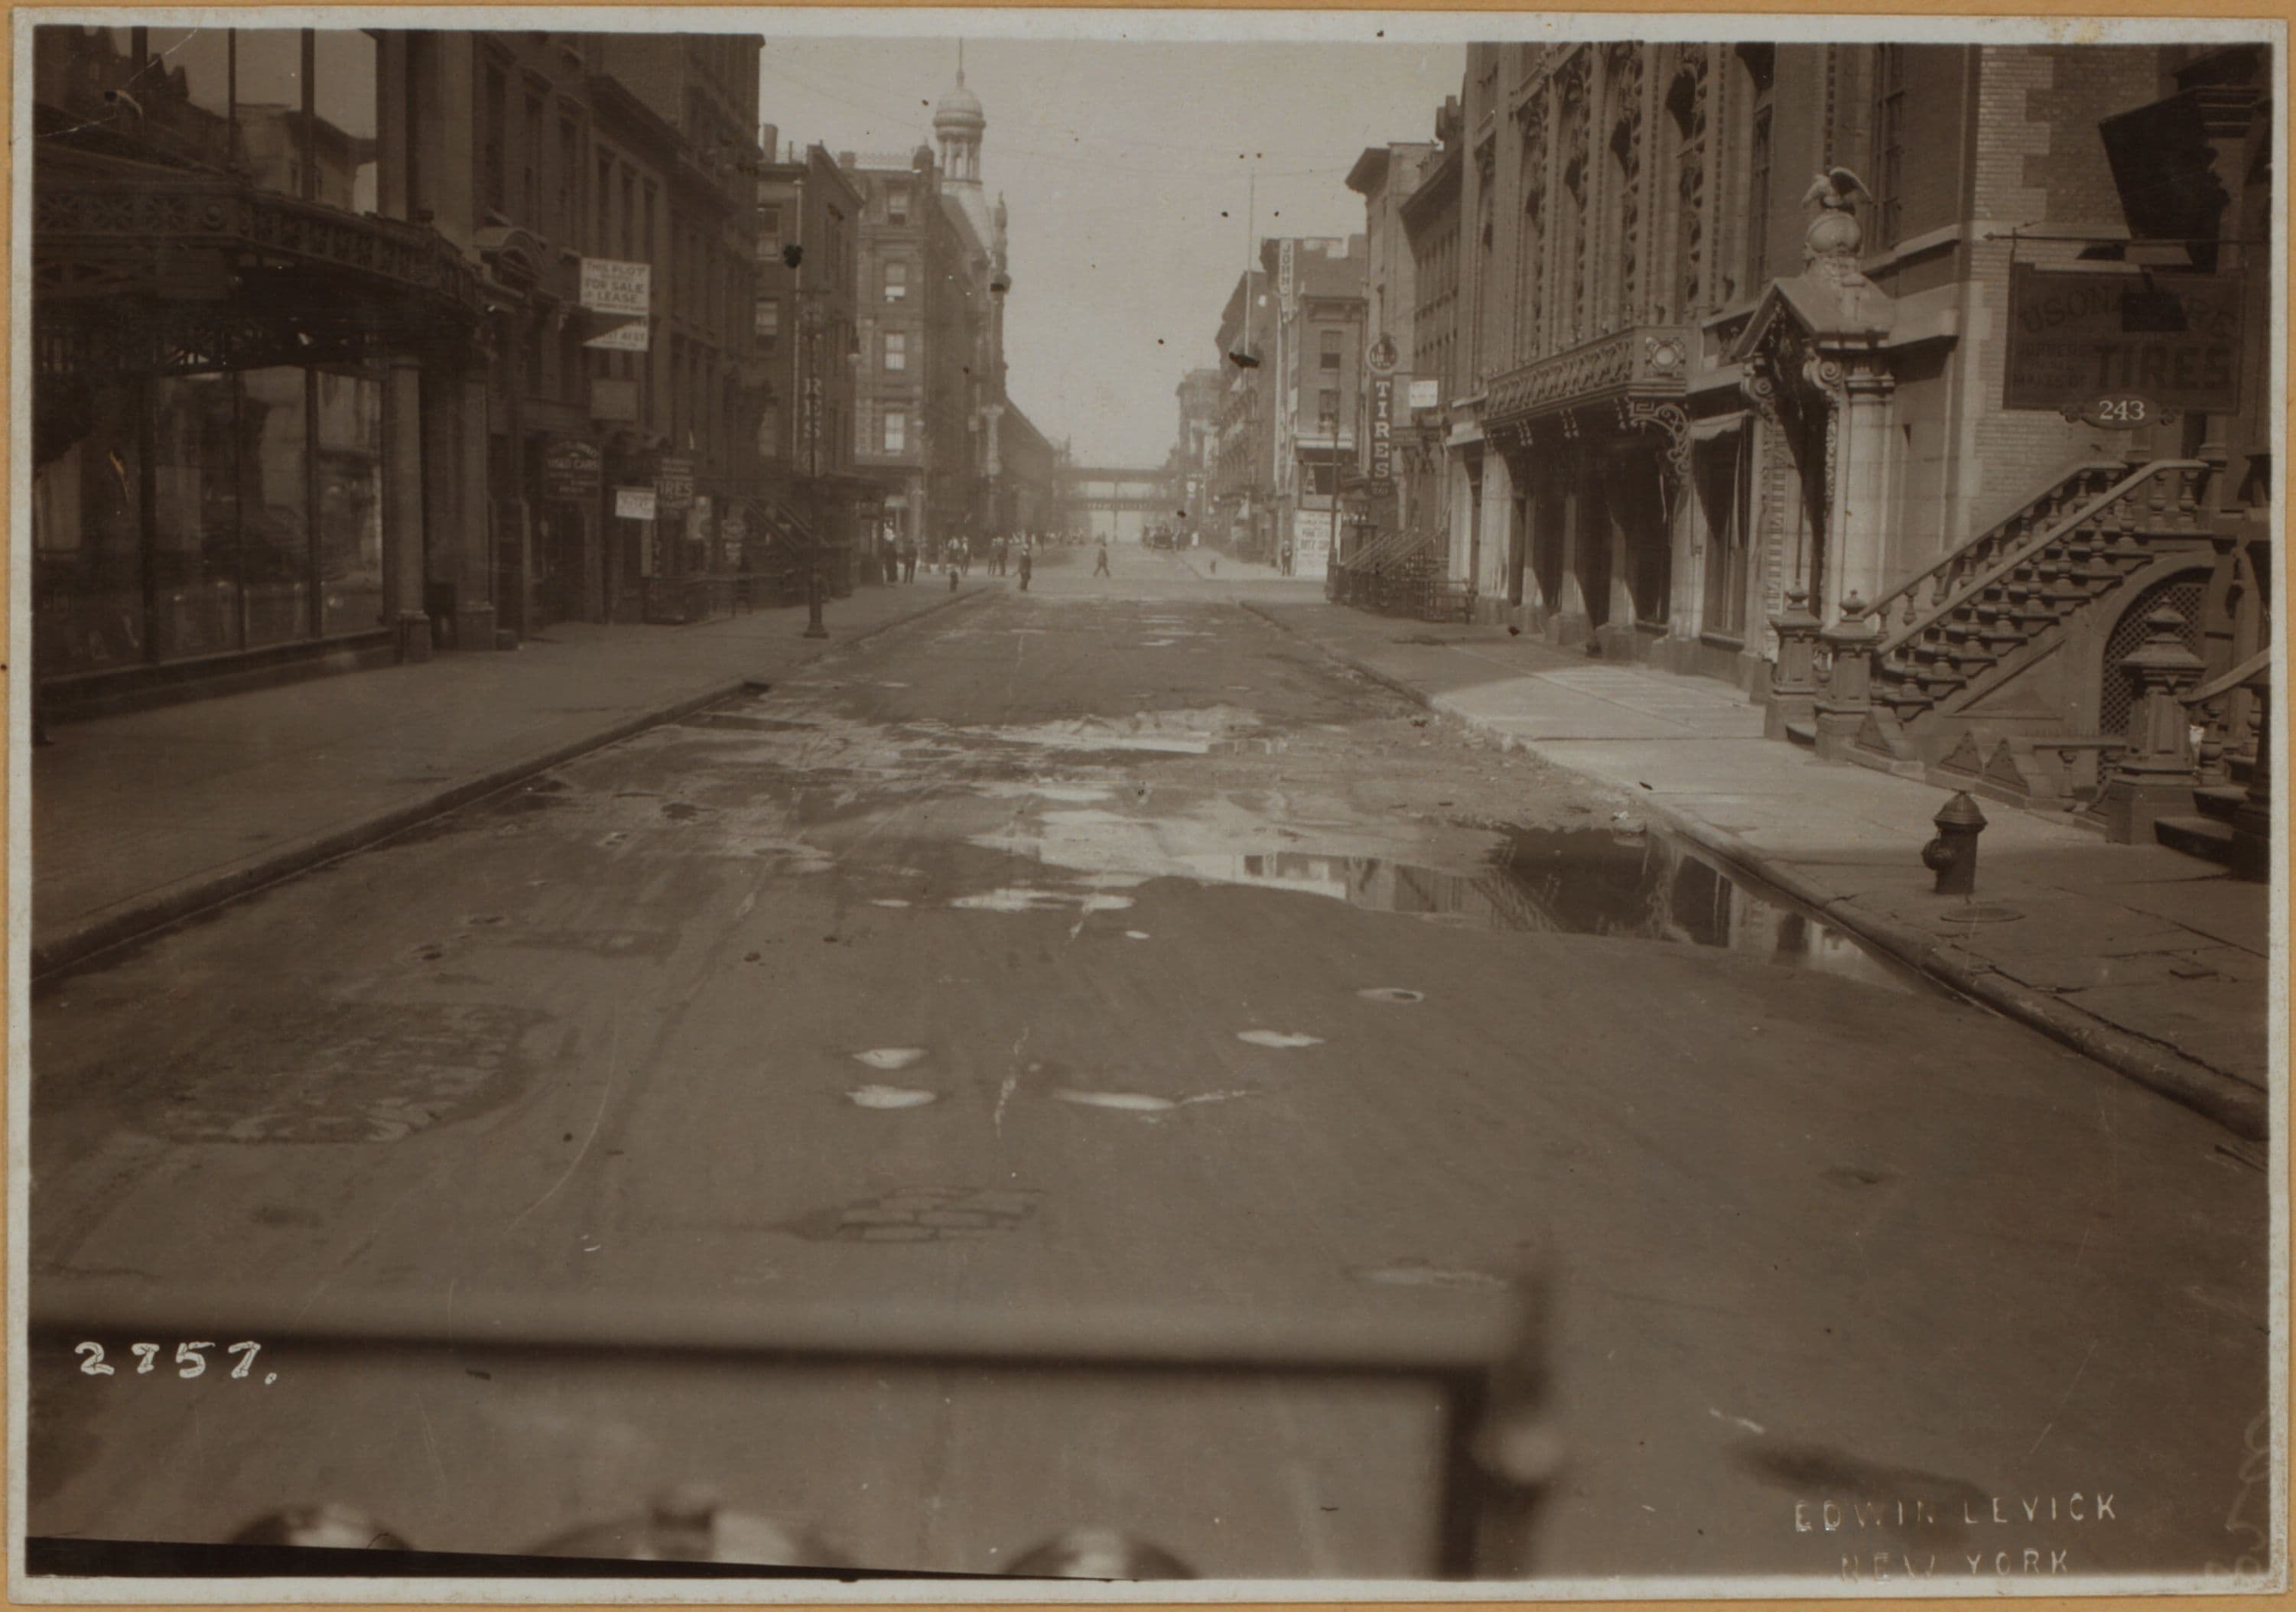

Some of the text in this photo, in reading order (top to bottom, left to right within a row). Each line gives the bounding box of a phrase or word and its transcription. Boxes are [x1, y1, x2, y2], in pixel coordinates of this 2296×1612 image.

[612, 265, 646, 276] PLOT
[585, 278, 643, 293] FOR SALE
[597, 291, 637, 304] LEASE
[2093, 342, 2233, 390] TIRES
[2098, 400, 2146, 421] 243
[1374, 380, 1392, 479] TIRES
[655, 480, 694, 498] TIRES
